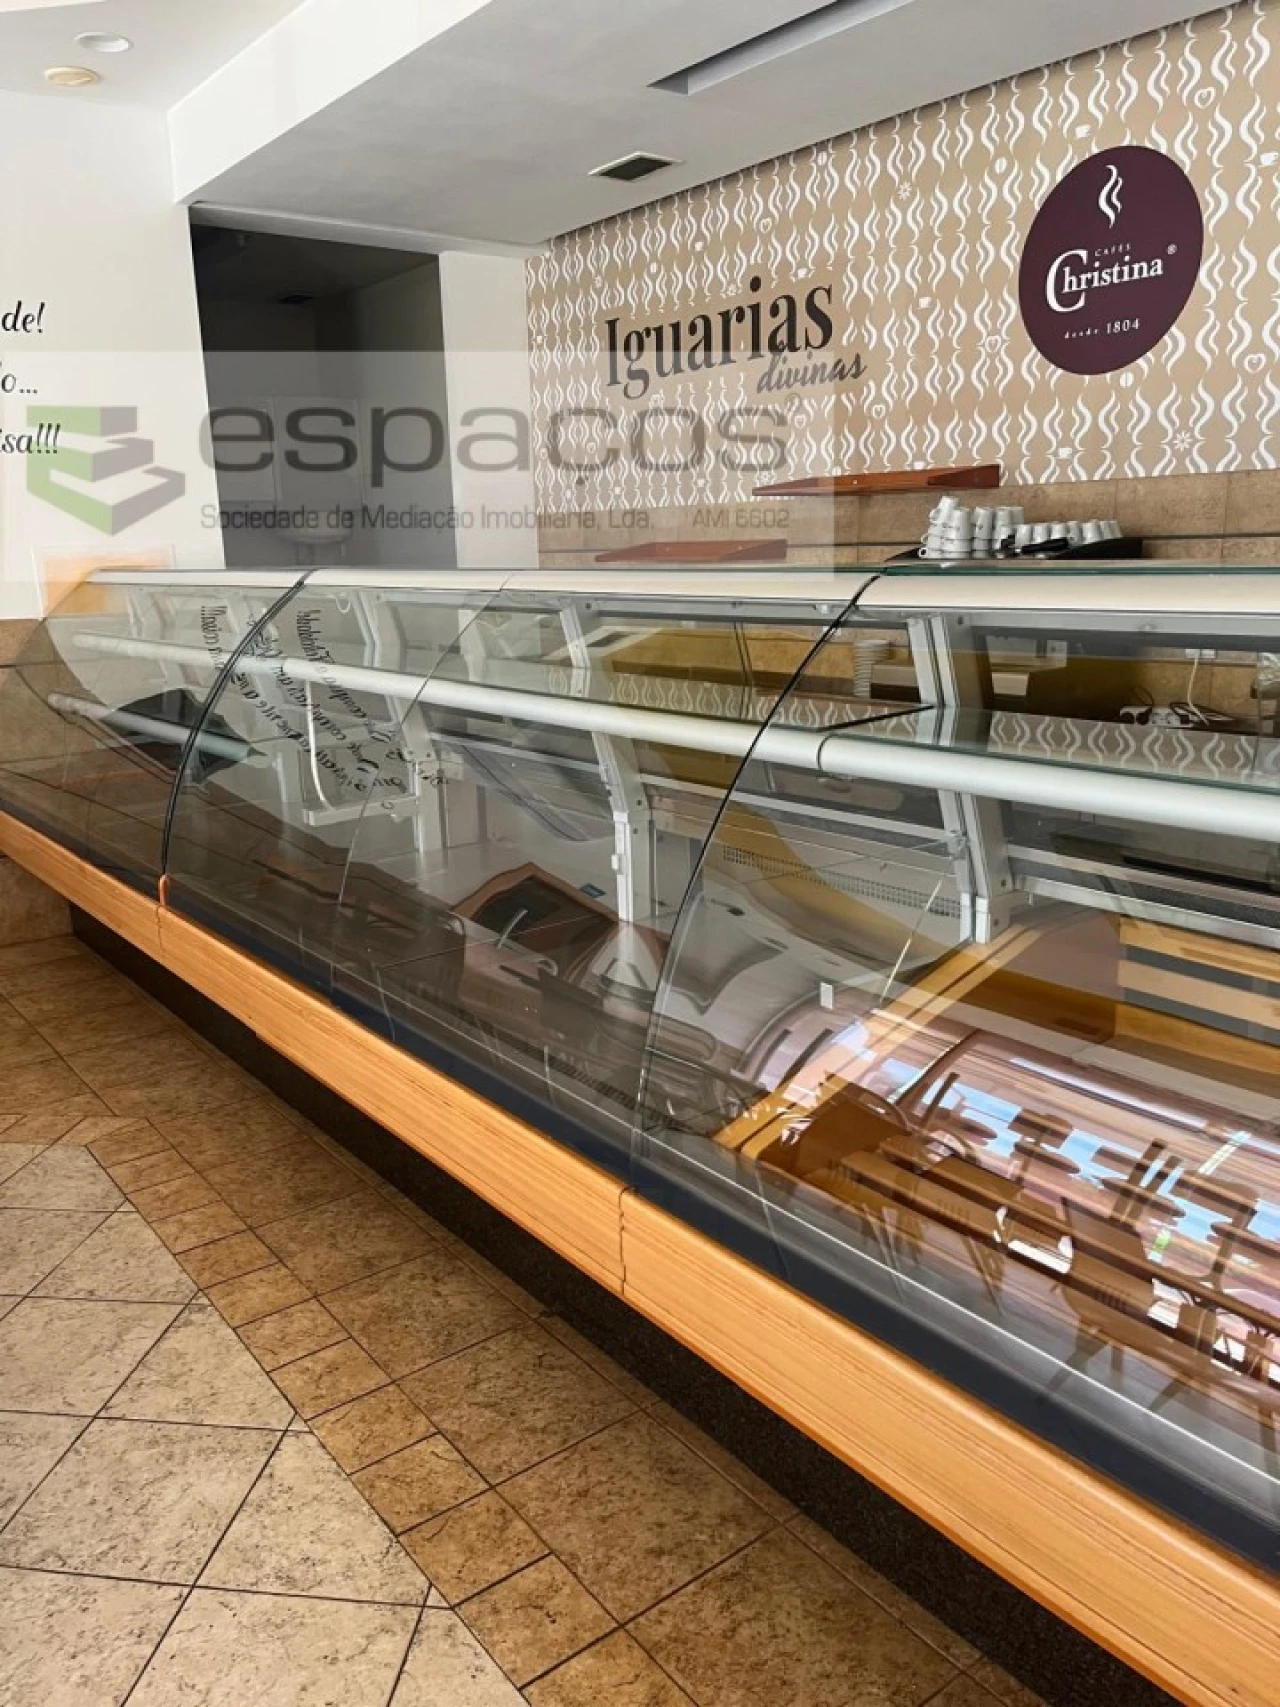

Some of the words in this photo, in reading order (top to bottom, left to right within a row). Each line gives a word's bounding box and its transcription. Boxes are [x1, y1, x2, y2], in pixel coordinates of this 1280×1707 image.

[1046, 248, 1164, 313] Christina
[604, 275, 833, 400] Iguarias
[1105, 317, 1140, 335] 1804
[756, 340, 868, 394] divinas
